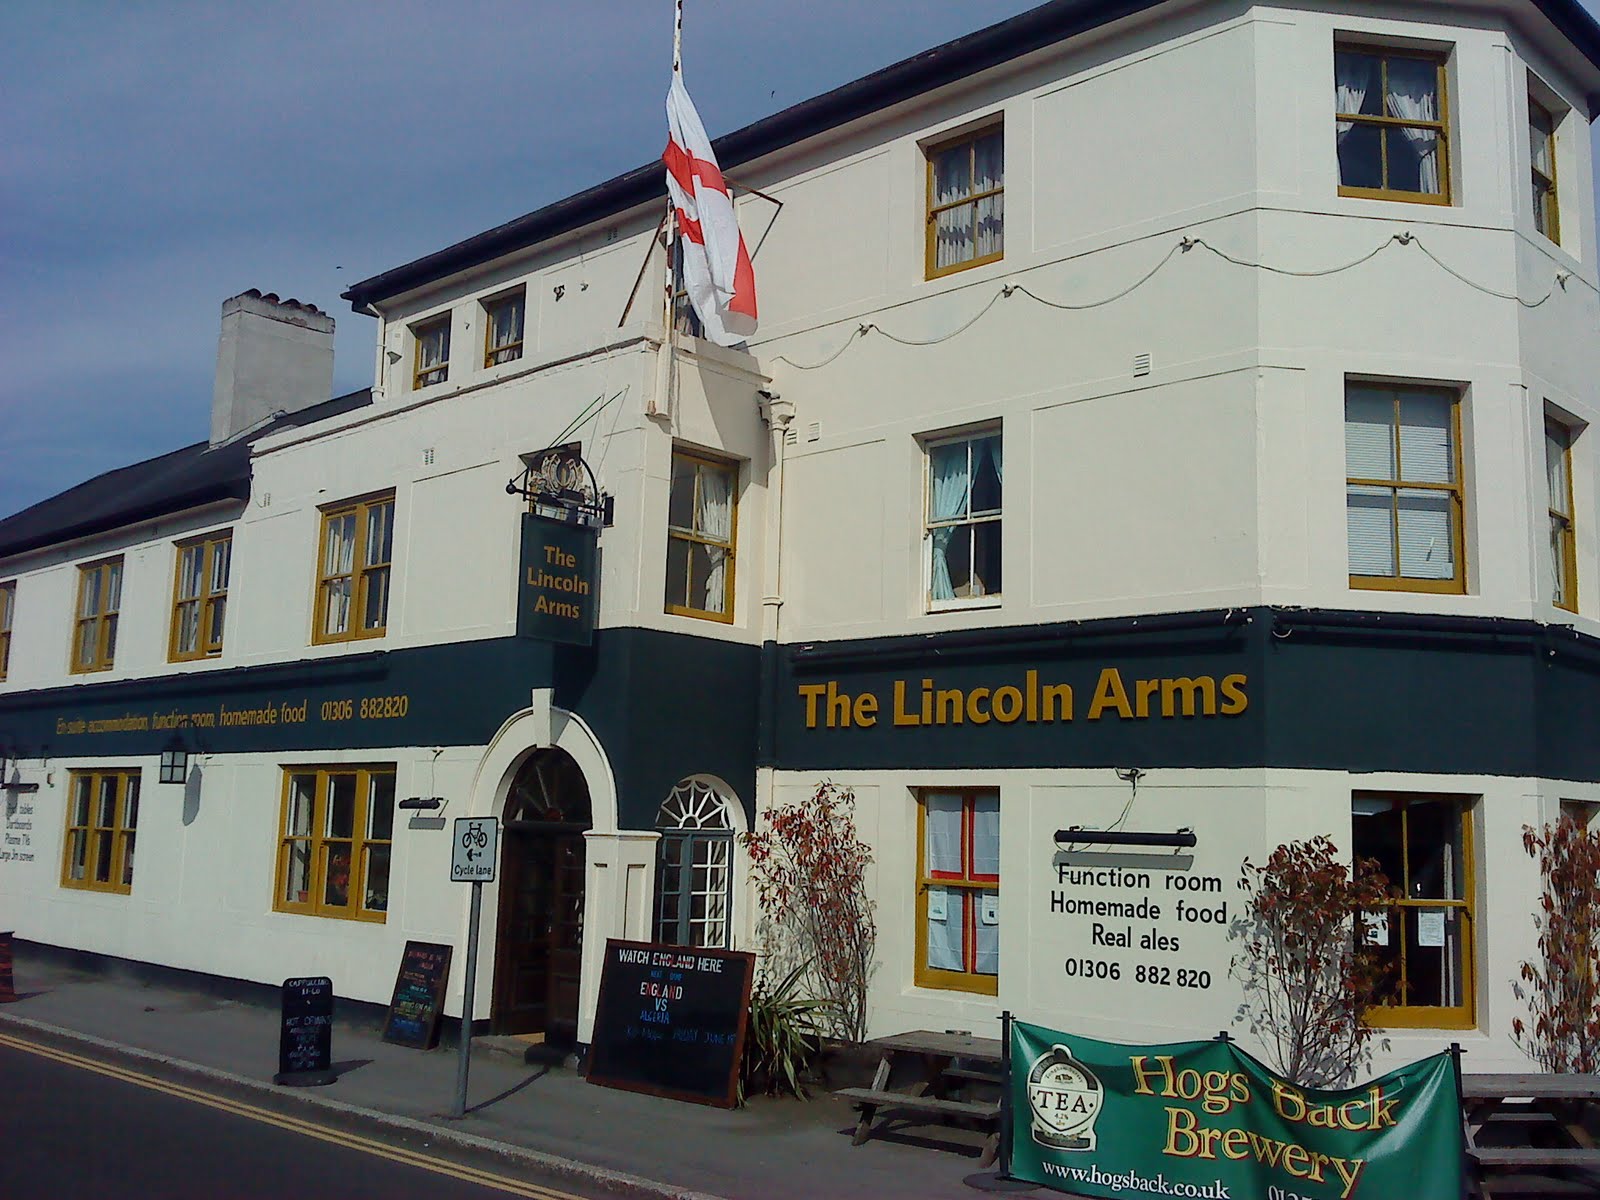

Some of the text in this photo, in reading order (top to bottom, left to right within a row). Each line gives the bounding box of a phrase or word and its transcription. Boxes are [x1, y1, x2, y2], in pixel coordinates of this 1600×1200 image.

[544, 546, 576, 568] The
[527, 567, 589, 595] Lincoln
[535, 596, 580, 619] Arms
[799, 667, 1249, 728] The Lincoln Arms
[152, 708, 188, 730] function
[220, 702, 277, 726] homemade
[281, 699, 307, 723] food
[321, 700, 352, 721] 01306
[360, 695, 408, 719] 882820
[455, 865, 491, 876] Cycle lane
[1058, 863, 1222, 892] Function room
[1051, 891, 1227, 924] Homemade food
[1092, 923, 1180, 951] Real ales
[619, 949, 723, 973] WATCH ENGLAND HERE
[1065, 958, 1121, 980] 01306
[640, 982, 683, 1000] ENGLAND
[640, 1010, 670, 1024] ALGERIA
[655, 998, 668, 1011] VS
[1037, 1090, 1088, 1114] TEA
[1129, 1055, 1251, 1114] Hogs
[1269, 1076, 1400, 1131] Back
[1163, 1106, 1366, 1200] Brewery
[1042, 1161, 1231, 1200] www.hogsback.co.uk
